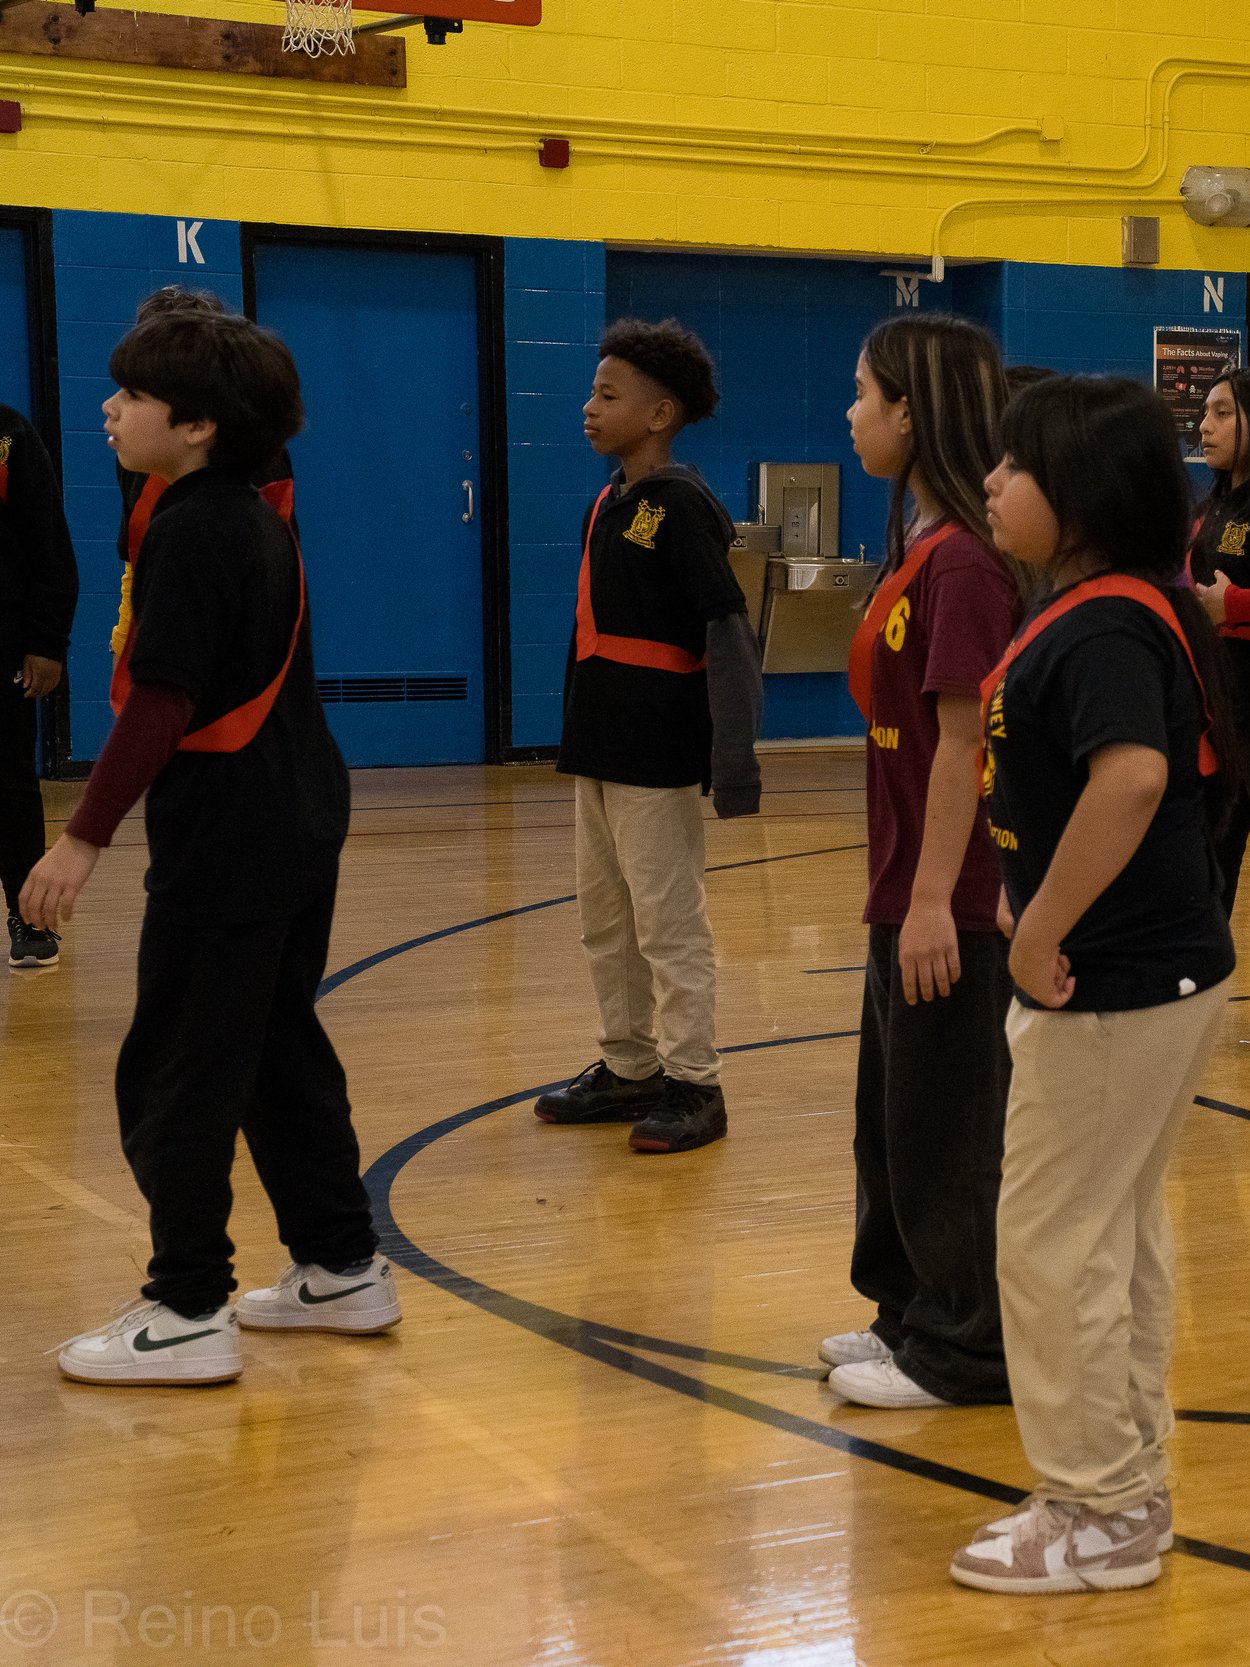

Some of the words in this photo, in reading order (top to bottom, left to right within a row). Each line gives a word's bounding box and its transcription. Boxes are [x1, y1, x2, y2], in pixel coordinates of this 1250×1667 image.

[177, 220, 206, 264] K
[896, 274, 919, 307] M
[1203, 275, 1224, 313] N
[1162, 347, 1176, 356] The
[1177, 348, 1195, 357] Facts
[1211, 351, 1229, 359] Vaping
